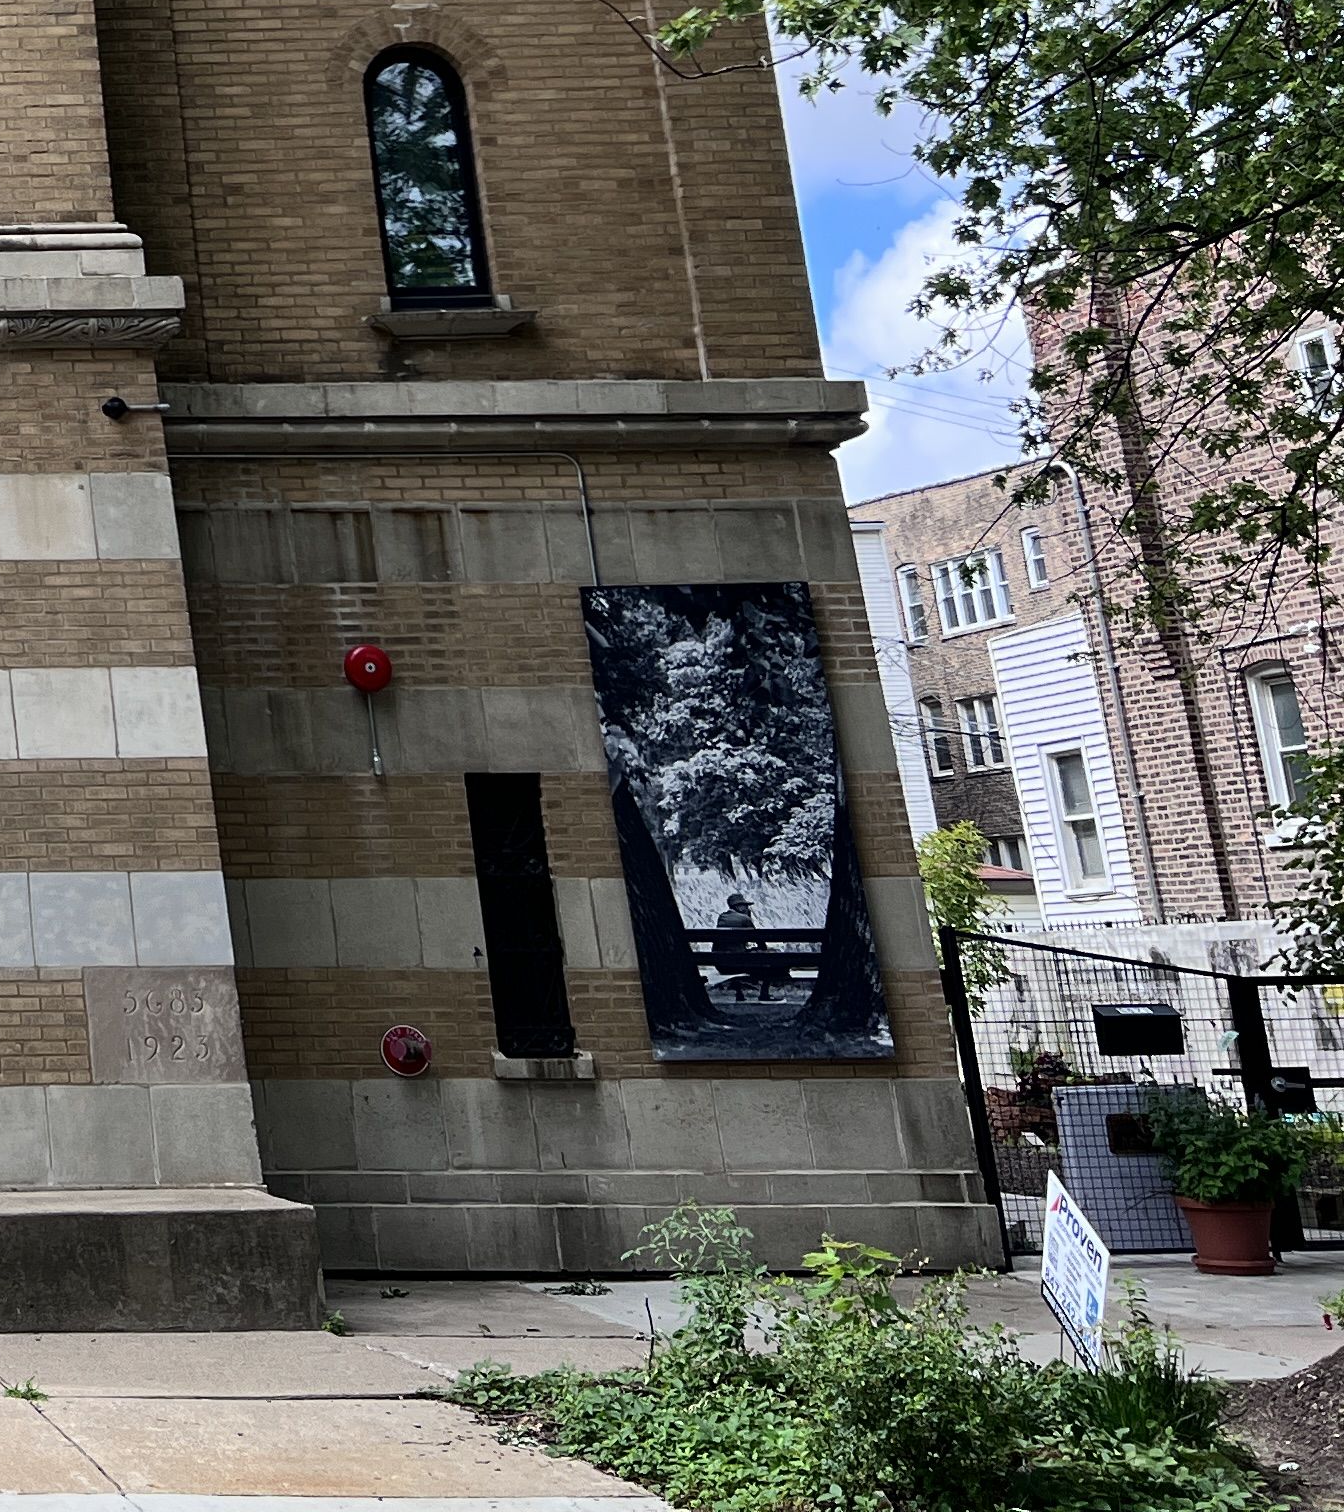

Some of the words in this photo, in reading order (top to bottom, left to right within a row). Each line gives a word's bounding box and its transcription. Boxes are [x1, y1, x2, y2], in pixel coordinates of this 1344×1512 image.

[123, 989, 204, 1015] 5683
[127, 1035, 210, 1061] 1923
[1059, 1194, 1102, 1273] Proven
